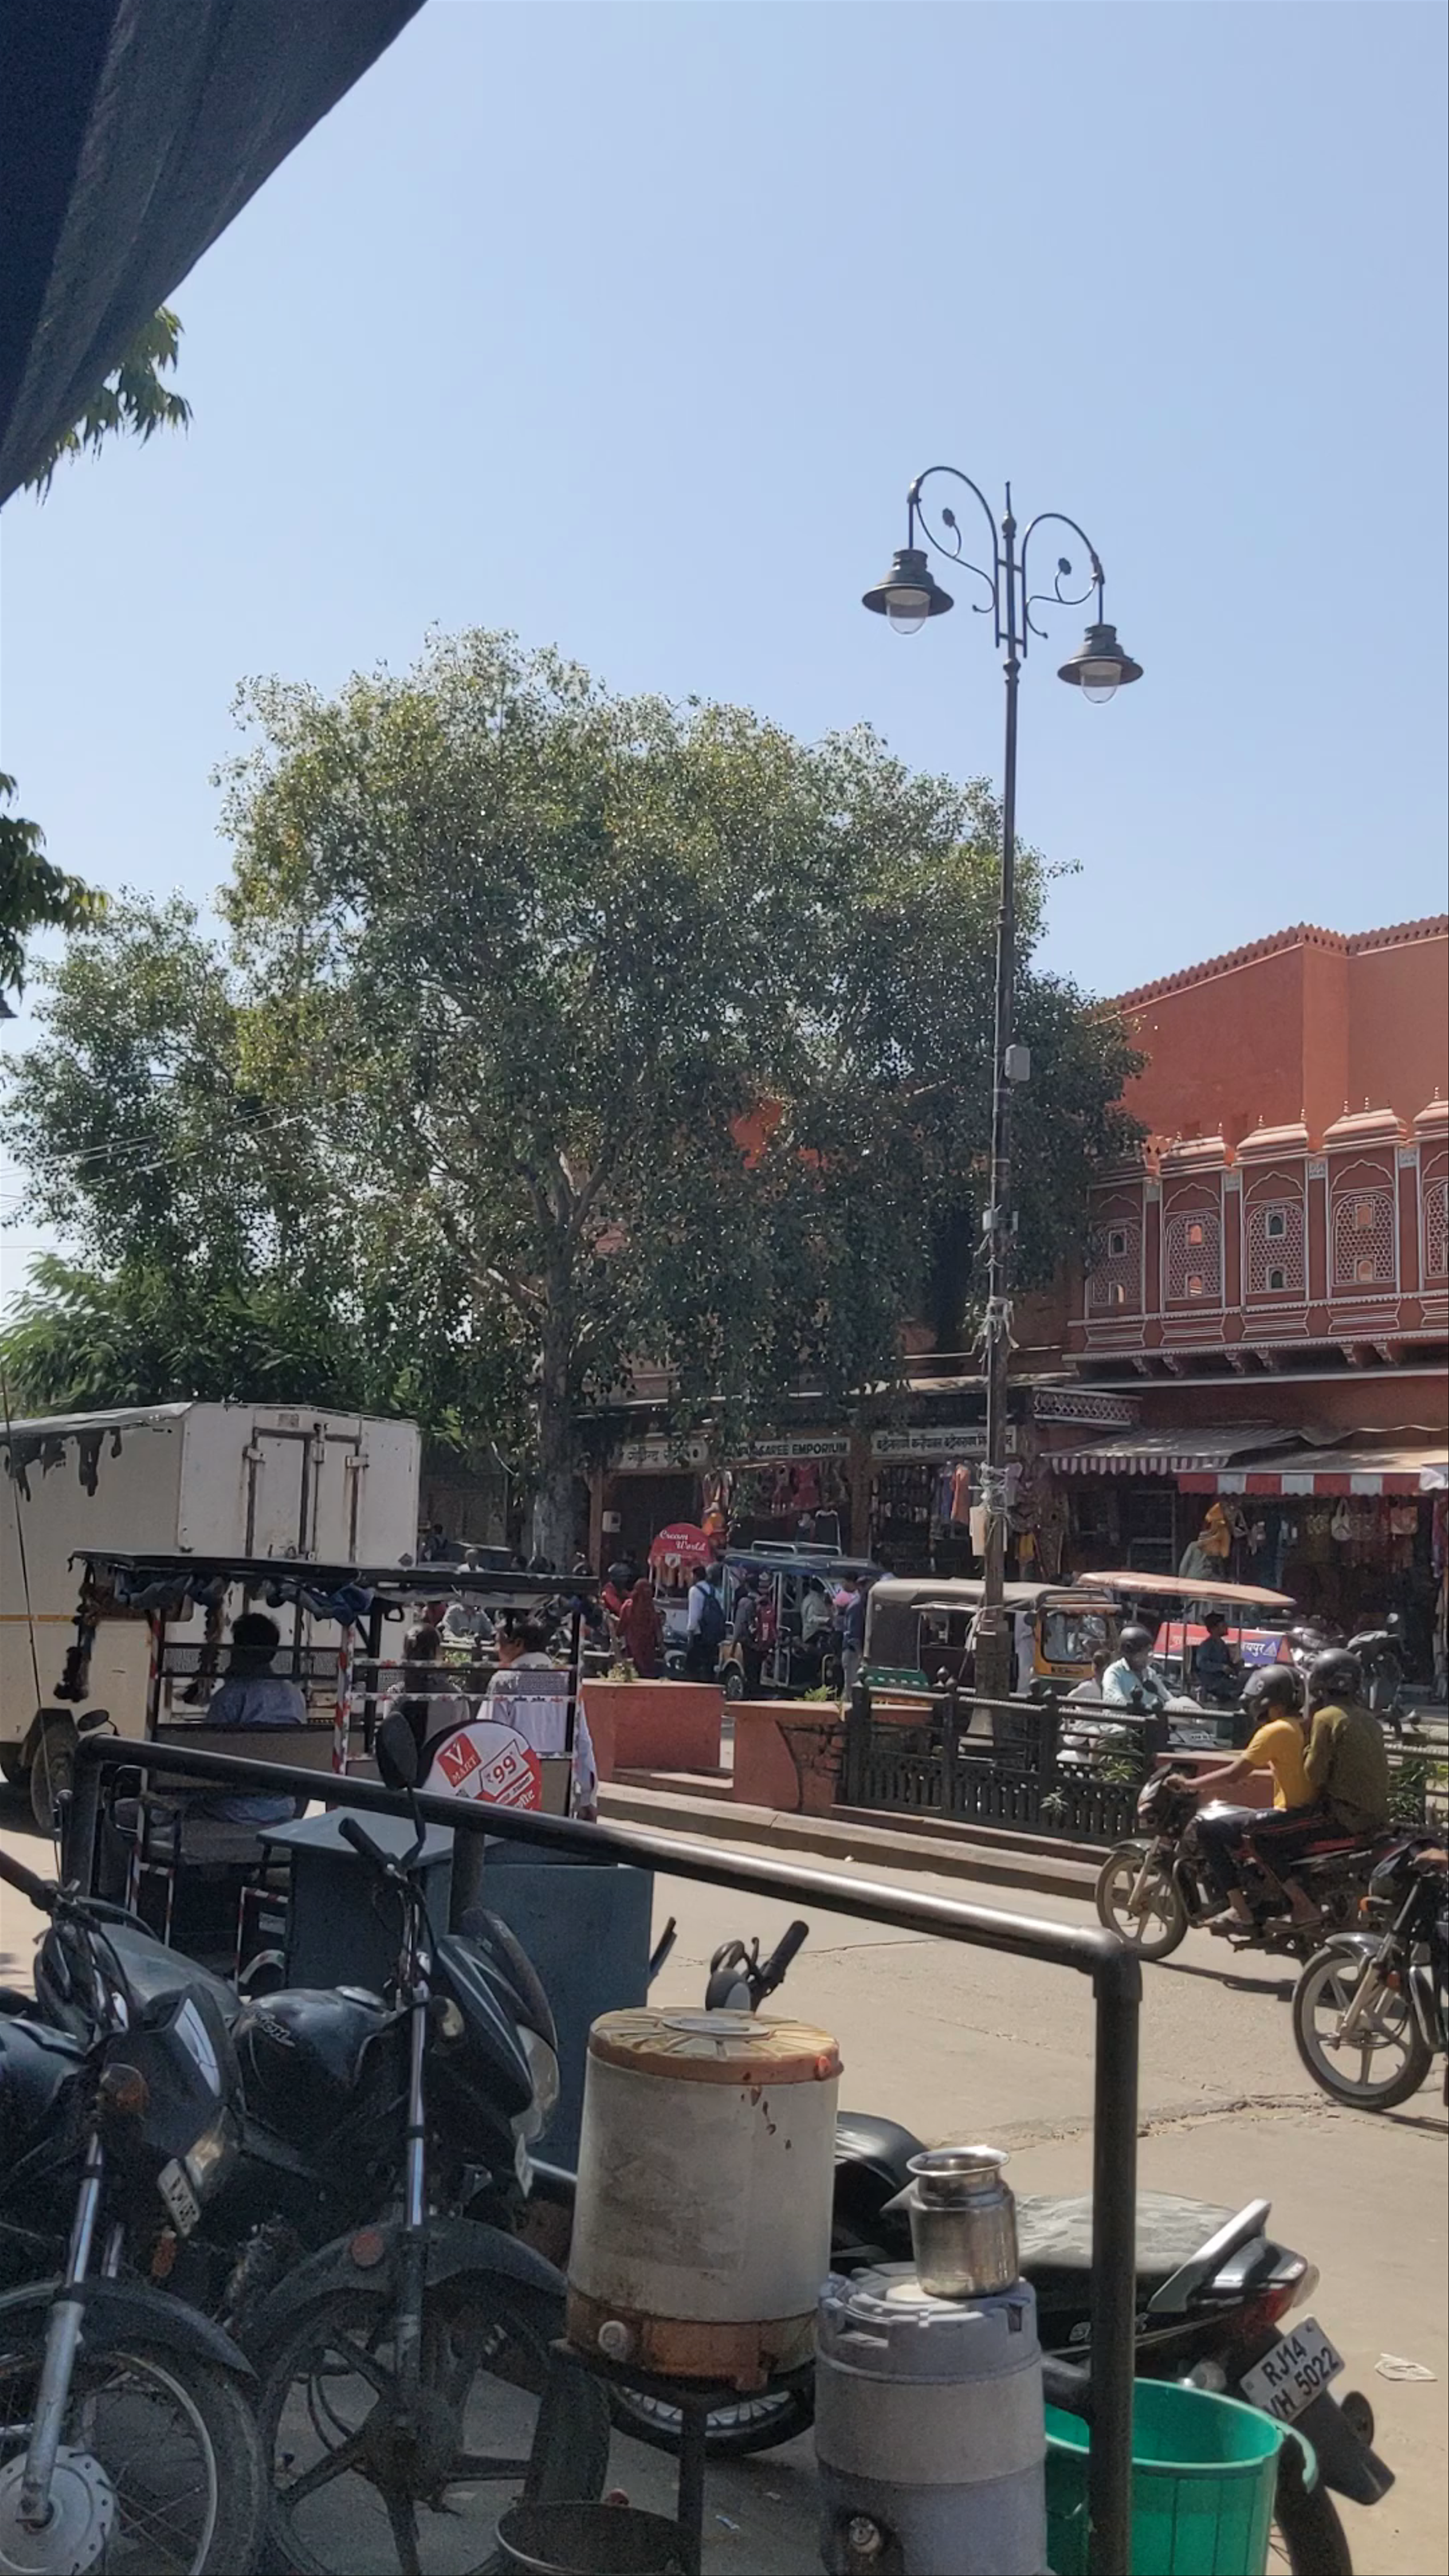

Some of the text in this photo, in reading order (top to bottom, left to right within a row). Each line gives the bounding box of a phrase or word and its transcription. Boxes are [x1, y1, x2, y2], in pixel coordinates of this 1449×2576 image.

[792, 1442, 848, 1455] EMPORIUM
[660, 1530, 688, 1540] Cream
[676, 1541, 706, 1551] World
[451, 1755, 477, 1782] MART
[1261, 2336, 1307, 2387] RJ14
[1294, 2346, 1339, 2396] 5022
